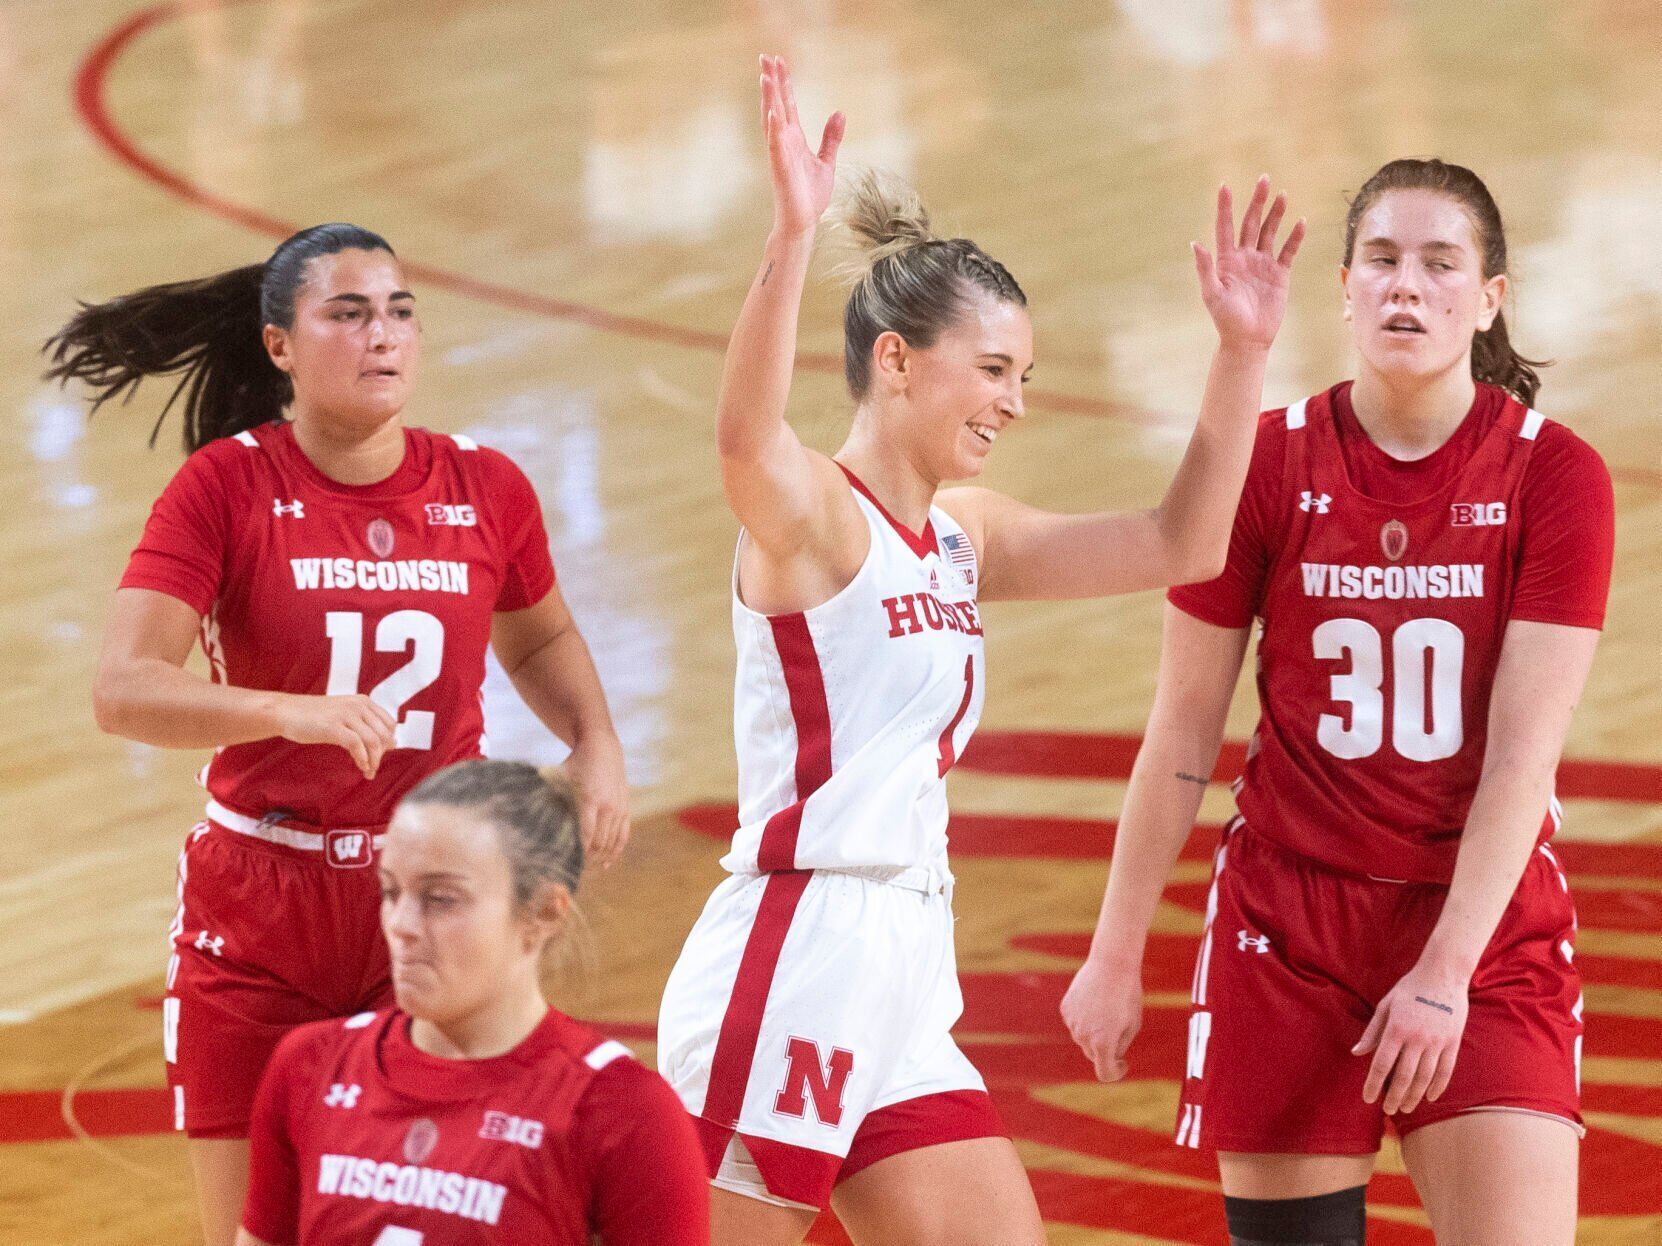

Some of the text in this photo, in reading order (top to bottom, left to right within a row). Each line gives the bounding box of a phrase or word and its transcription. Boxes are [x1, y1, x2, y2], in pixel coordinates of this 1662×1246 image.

[291, 558, 468, 594] WISCONSIN
[1302, 564, 1484, 599] WISCONSIN
[326, 609, 445, 749] 12
[1312, 618, 1464, 762] 30
[333, 834, 363, 861] W
[773, 1036, 854, 1128] N
[318, 1154, 508, 1225] WISCONSIN
